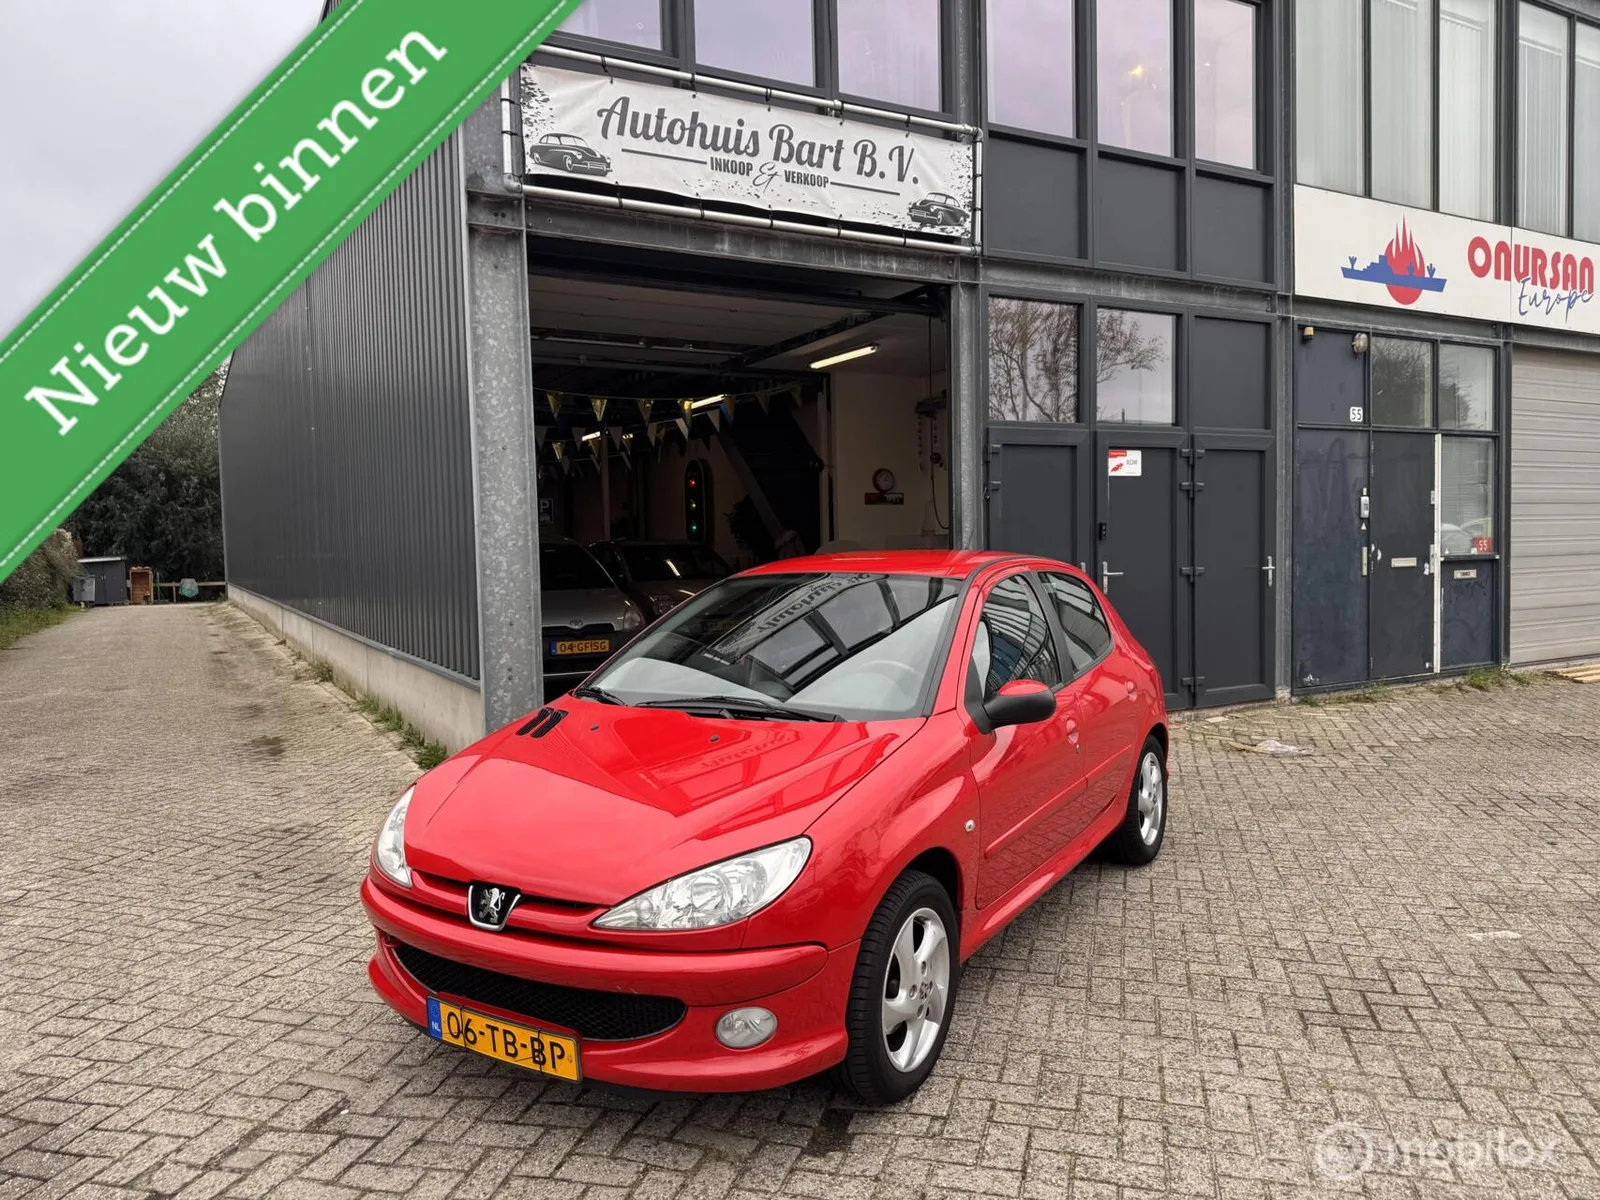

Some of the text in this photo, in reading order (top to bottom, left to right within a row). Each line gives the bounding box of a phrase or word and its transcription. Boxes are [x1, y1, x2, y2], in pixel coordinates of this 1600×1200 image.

[596, 96, 919, 185] Autohuis Bart B.V.
[709, 156, 754, 177] INKOOP
[783, 169, 830, 189] VERKOOP
[1467, 236, 1595, 295] ONURSAN
[1518, 276, 1594, 323] Europe
[1351, 408, 1362, 421] 55
[1478, 539, 1488, 551] 55
[446, 1011, 565, 1070] 06-TB-BP
